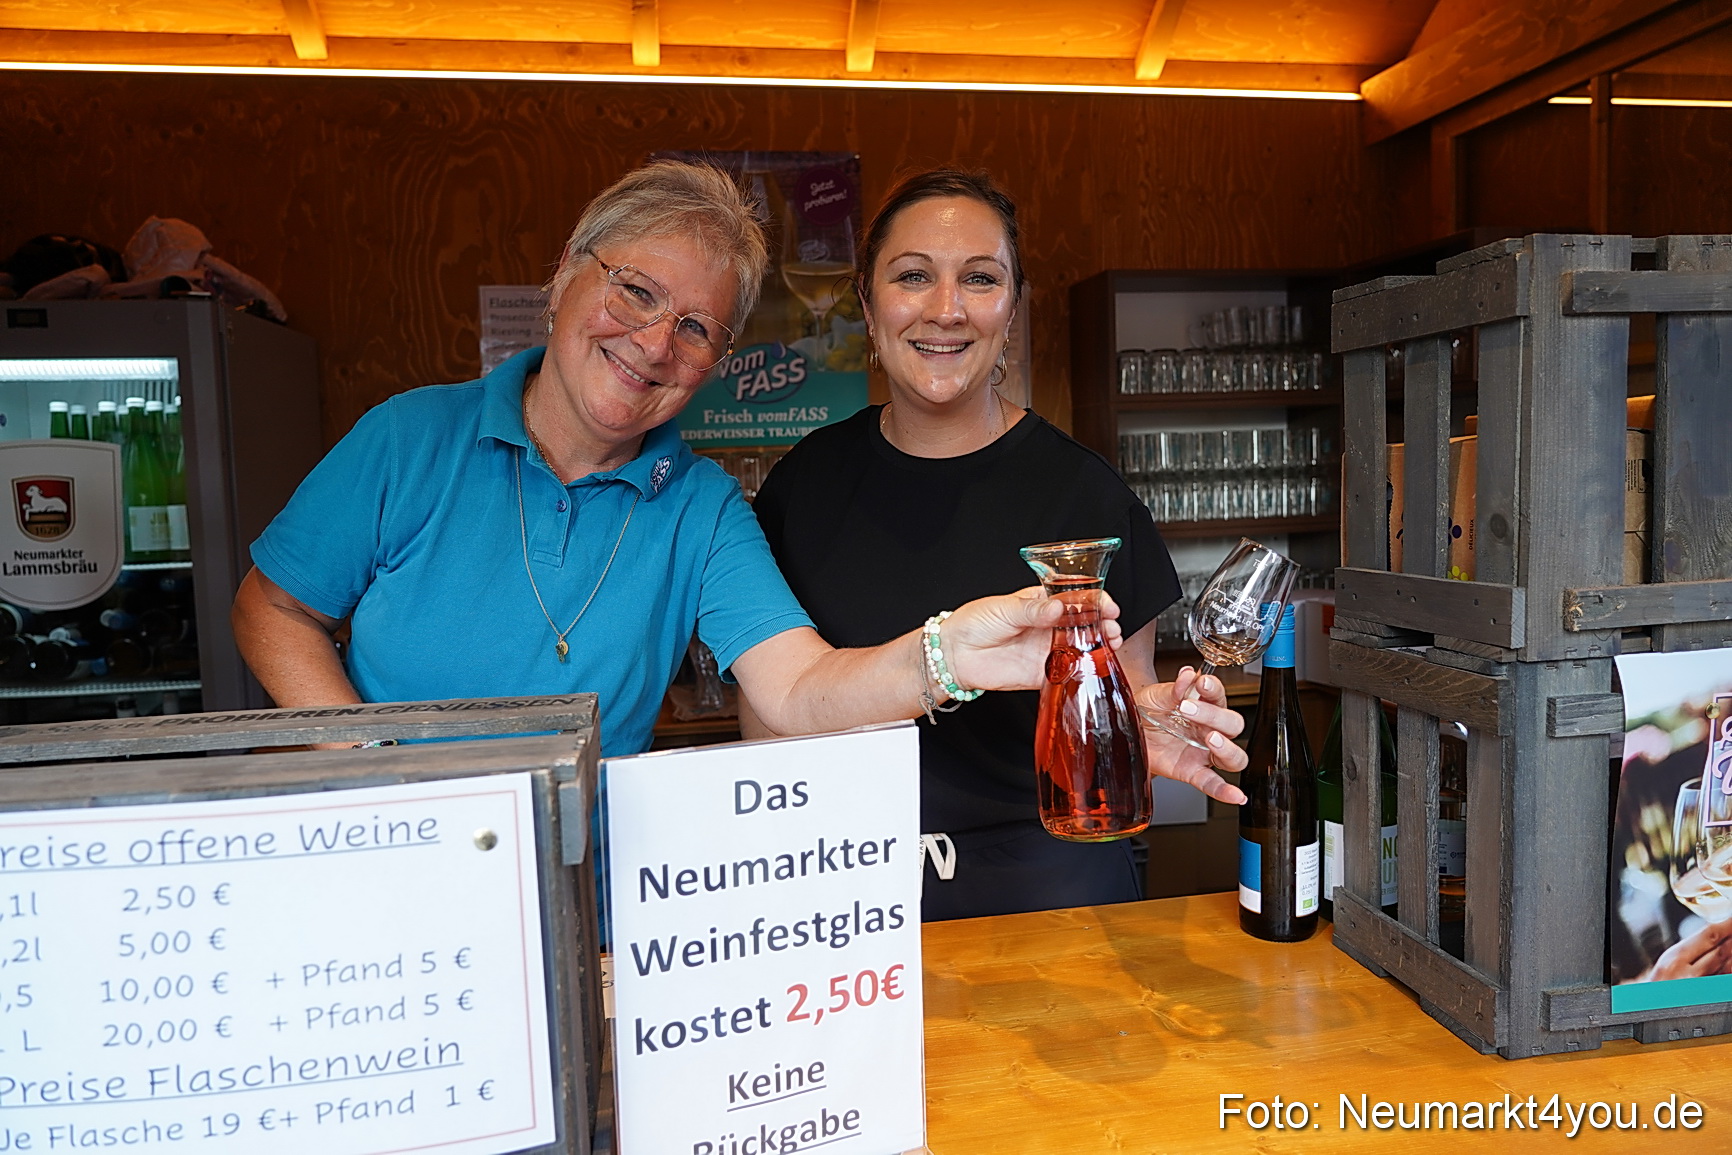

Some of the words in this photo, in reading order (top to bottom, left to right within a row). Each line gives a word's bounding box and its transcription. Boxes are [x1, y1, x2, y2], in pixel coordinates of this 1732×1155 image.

[721, 350, 765, 378] vom
[736, 357, 806, 400] FASS
[680, 428, 765, 440] EDERWEISSER
[703, 408, 753, 424] Frisch
[757, 406, 829, 422] vomFASS
[2, 560, 98, 576] Lammsbräu
[14, 548, 83, 560] Neumarkter
[152, 707, 365, 726] PROBIEREN
[374, 697, 578, 715] GENIESSEN
[733, 779, 809, 816] Das
[0, 835, 107, 868] reise
[128, 828, 276, 866] offene
[299, 814, 441, 852] Weine
[638, 835, 897, 903] Neumarkter
[122, 886, 196, 917] 2,50
[212, 883, 232, 906] €
[118, 930, 192, 960] 5,00
[208, 928, 228, 952] €
[630, 901, 905, 977] Weinfestglas
[0, 985, 33, 1012] ,5
[100, 975, 195, 1005] 10,00
[211, 971, 230, 996] €
[266, 971, 286, 989] +
[302, 954, 404, 987] Pfand
[420, 951, 438, 974] 5
[454, 947, 472, 970] €
[23, 1029, 42, 1052] L
[102, 1019, 198, 1050] 20,00
[214, 1016, 233, 1039] €
[269, 1015, 288, 1032] +
[305, 997, 406, 1030] Pfand
[423, 993, 440, 1016] 5
[456, 989, 475, 1012] €
[635, 996, 772, 1056] kostet
[785, 963, 905, 1026] 2,50€
[0, 1071, 128, 1103] Preise
[148, 1036, 463, 1098] Flaschenwein
[728, 1057, 826, 1104] Keine
[0, 1127, 32, 1150] Je
[49, 1119, 184, 1149] Flasche
[202, 1113, 241, 1138] 19
[316, 1089, 416, 1124] Pfand
[445, 1085, 461, 1108] 1
[477, 1079, 496, 1102] €
